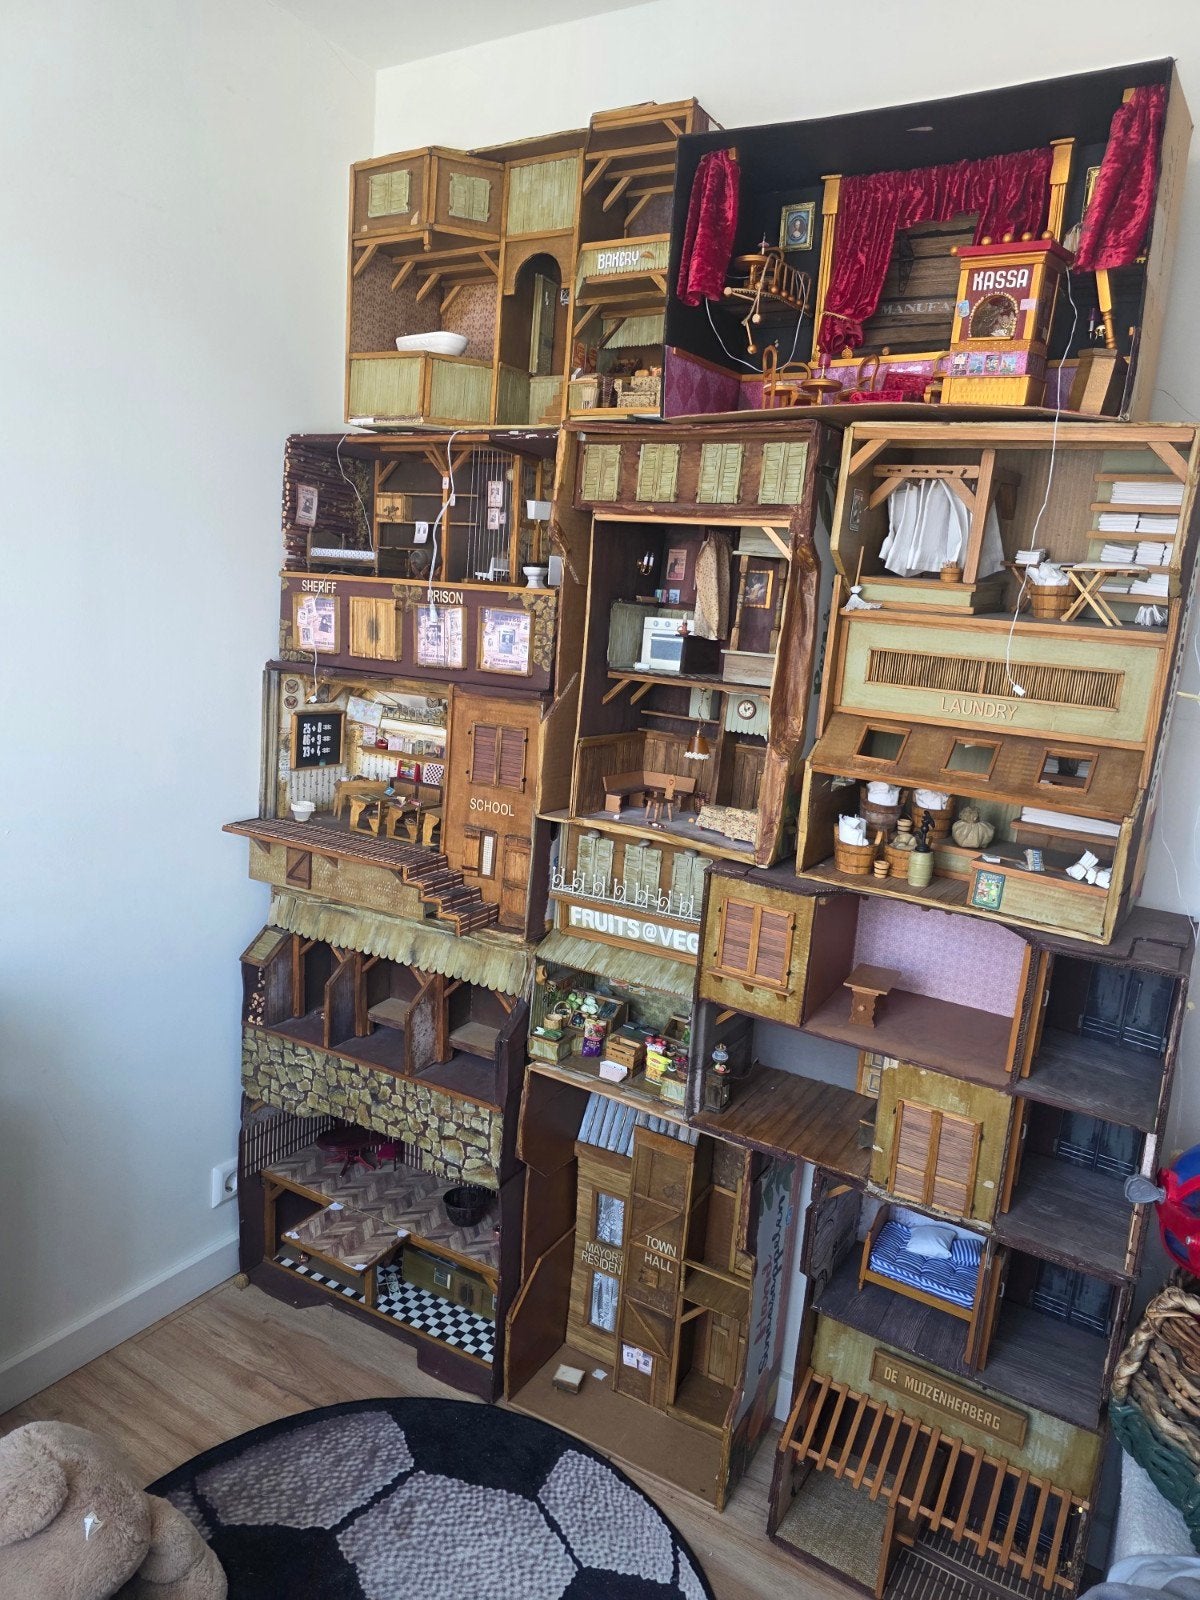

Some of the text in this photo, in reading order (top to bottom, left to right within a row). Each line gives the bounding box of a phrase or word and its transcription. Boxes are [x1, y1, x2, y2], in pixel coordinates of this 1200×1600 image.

[598, 250, 640, 269] BAKERY
[972, 268, 1029, 291] KASSA
[302, 580, 337, 593] SHERIFF
[427, 589, 463, 604] PRISON
[941, 697, 1018, 720] LAUNDRY
[470, 798, 515, 817] SCHOOL
[645, 1234, 677, 1257] TOWN
[644, 1252, 673, 1274] HALL
[884, 1366, 1001, 1430] DE MUIZENHERBERG
